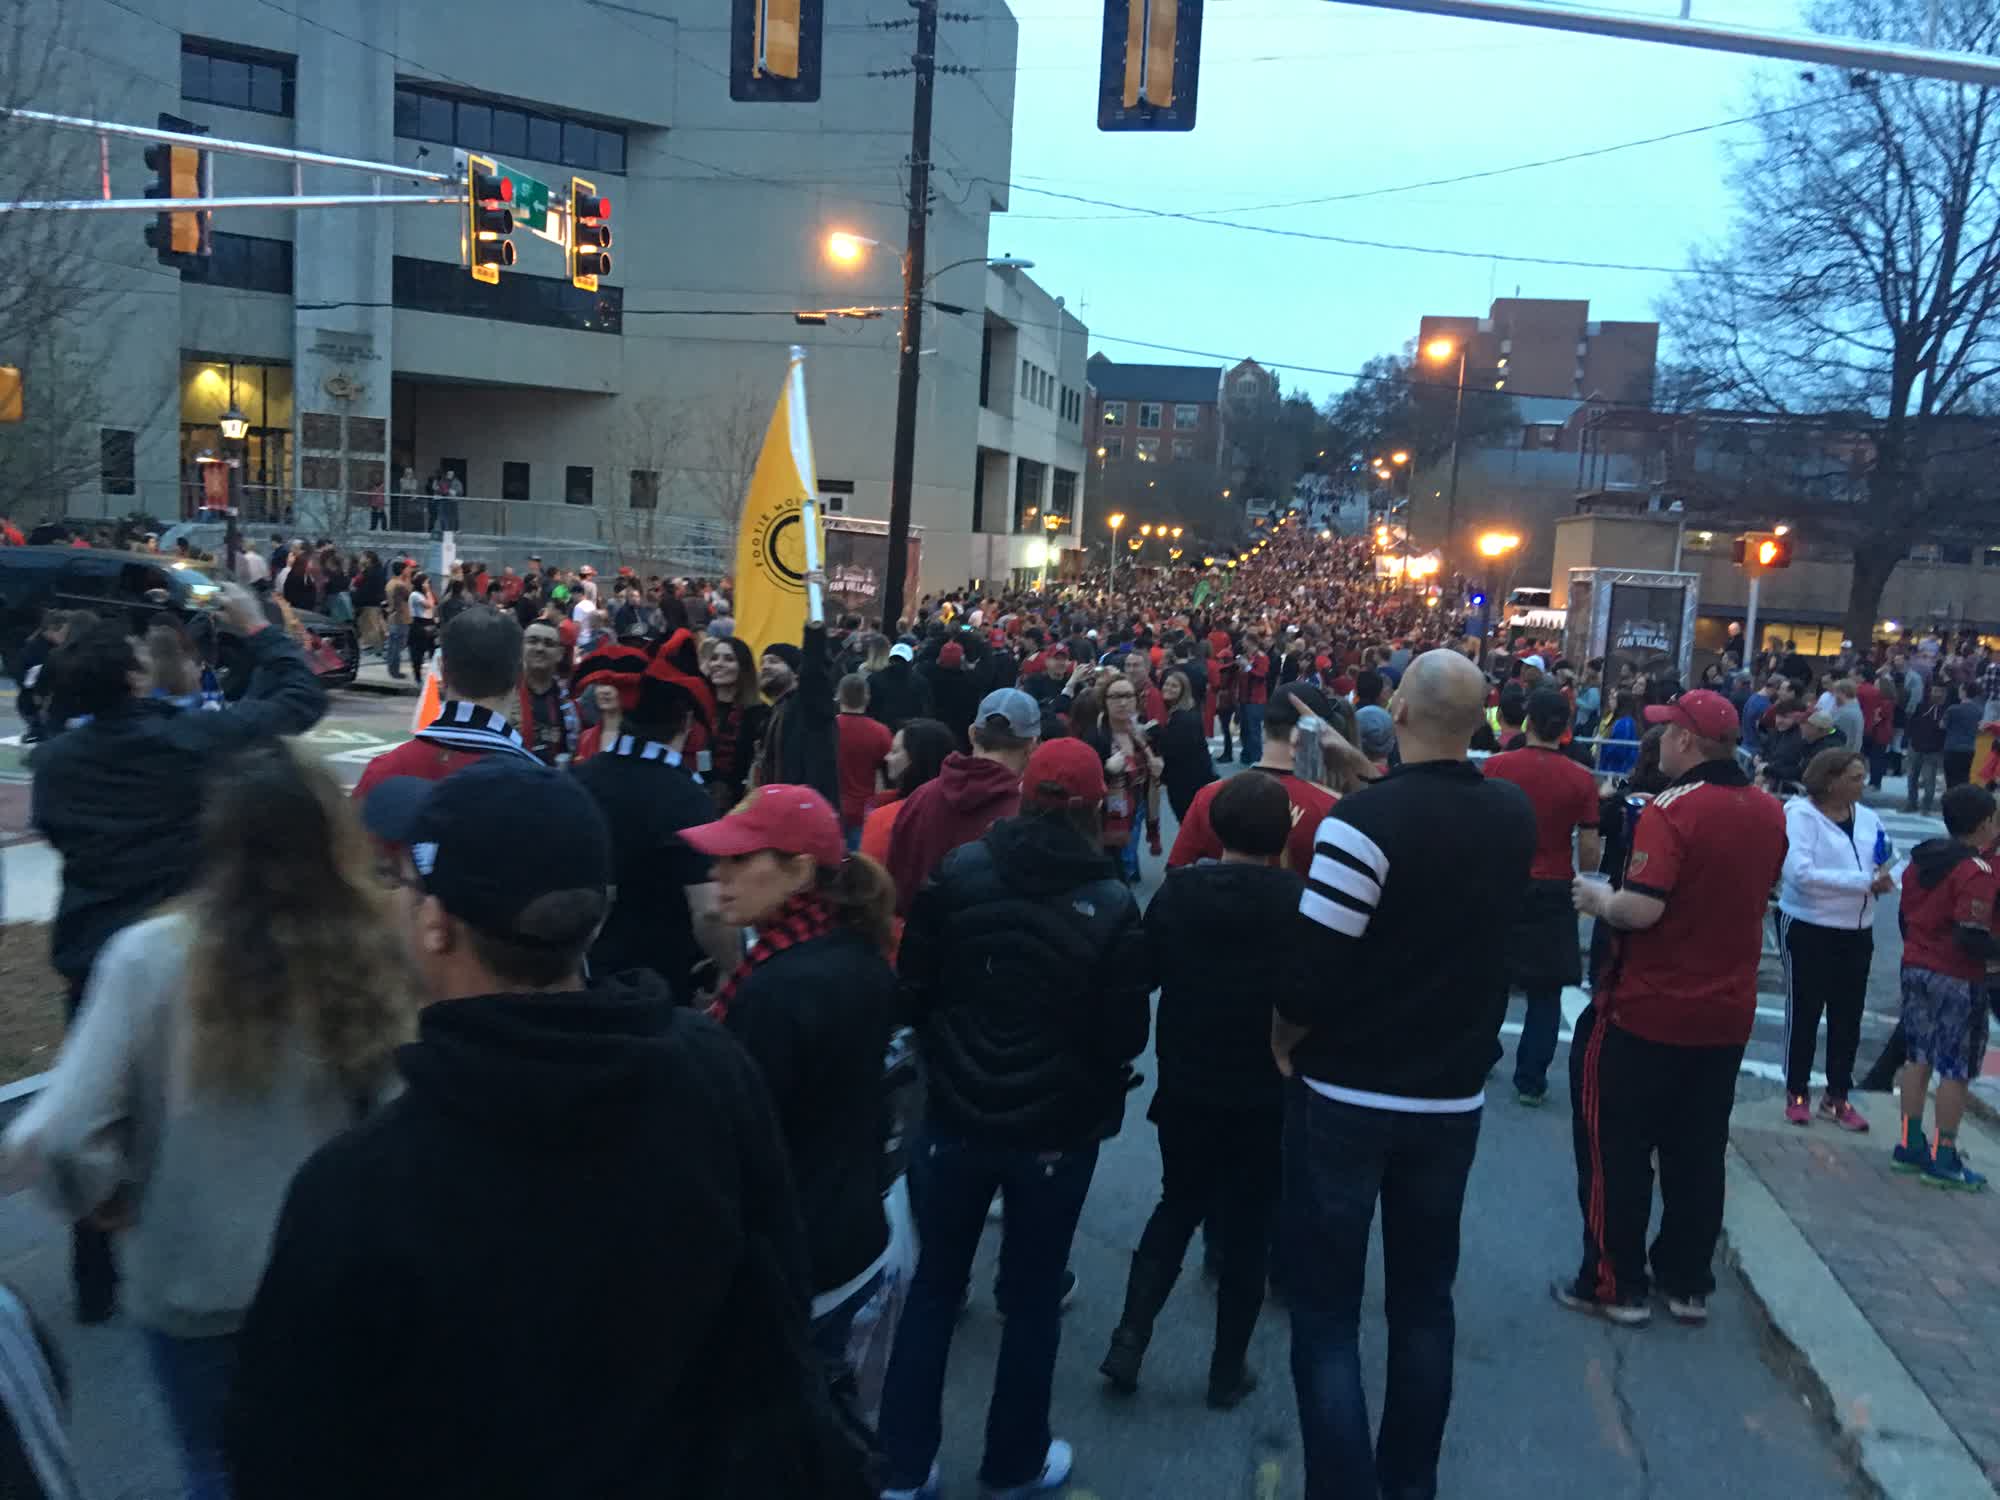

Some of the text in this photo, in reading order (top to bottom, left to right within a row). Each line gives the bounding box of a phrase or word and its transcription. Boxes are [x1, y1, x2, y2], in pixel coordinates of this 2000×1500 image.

[752, 513, 770, 567] FOOTIE
[829, 581, 876, 597] FAN VILLAGE
[1616, 636, 1670, 651] FAN VILLAGE
